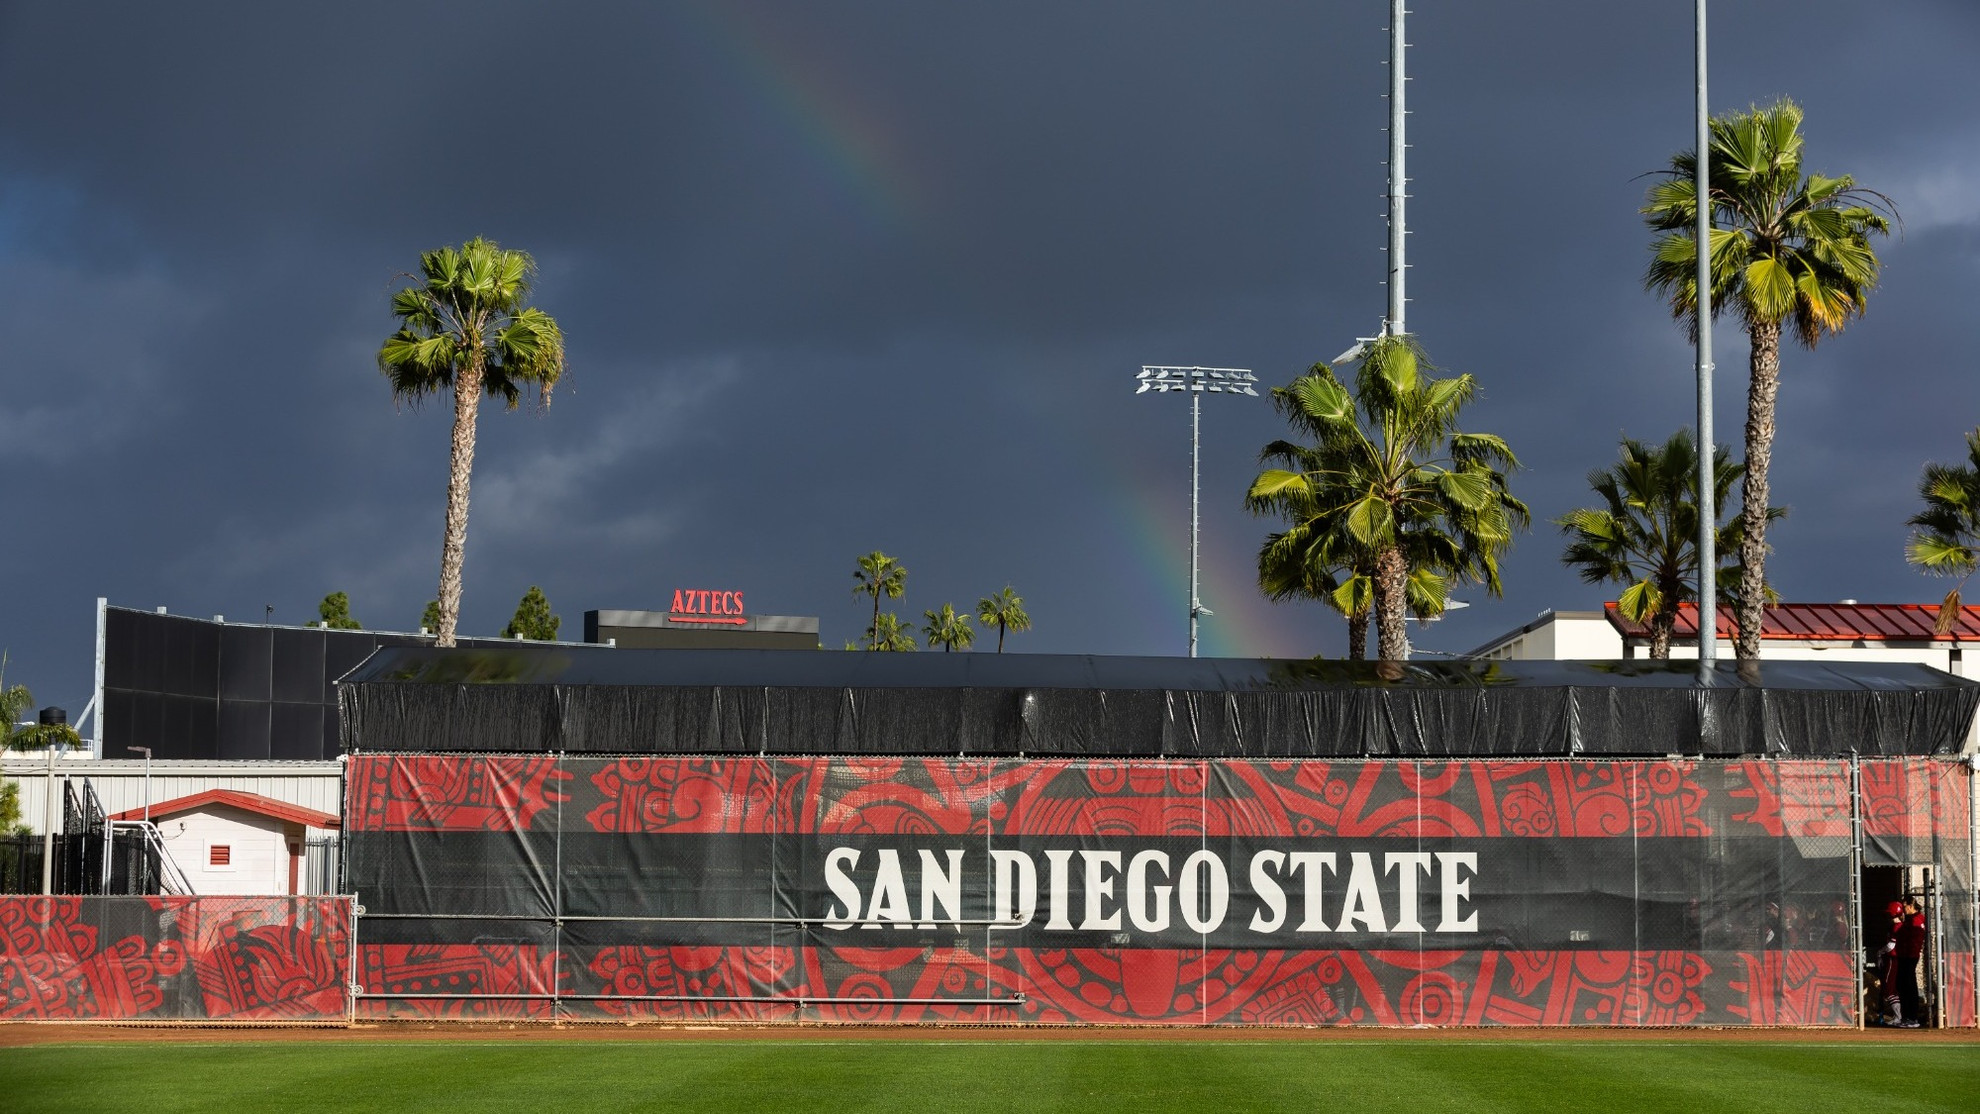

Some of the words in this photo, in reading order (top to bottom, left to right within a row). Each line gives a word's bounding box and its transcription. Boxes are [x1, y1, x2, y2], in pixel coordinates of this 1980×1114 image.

[670, 589, 744, 615] AZTECS
[822, 847, 965, 933] SAN
[988, 849, 1230, 934] DIEGO
[1248, 849, 1478, 934] STATE
